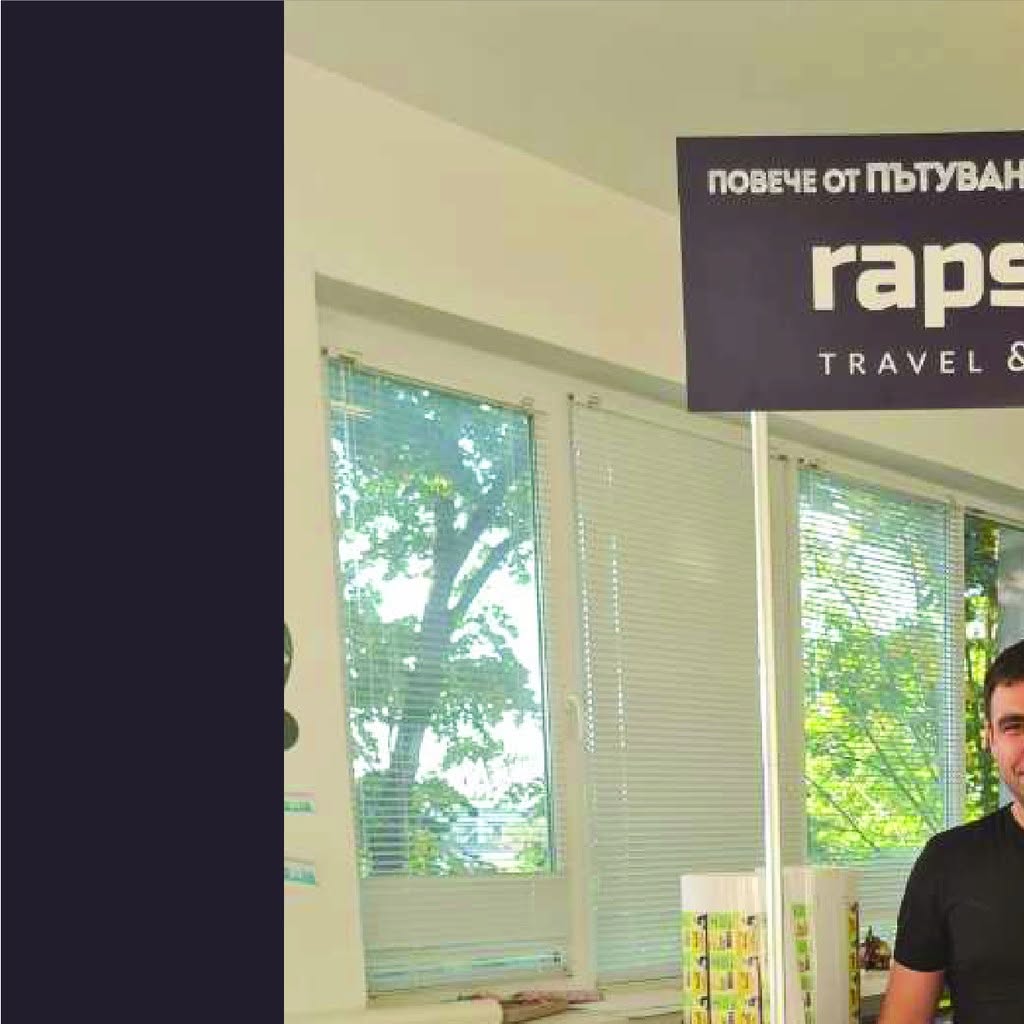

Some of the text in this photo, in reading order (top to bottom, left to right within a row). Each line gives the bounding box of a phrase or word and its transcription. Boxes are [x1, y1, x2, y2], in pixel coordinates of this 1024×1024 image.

[707, 168, 818, 196] ПОВЕЧЕ
[822, 167, 861, 194] ОТ
[818, 350, 983, 376] TRAVEL
